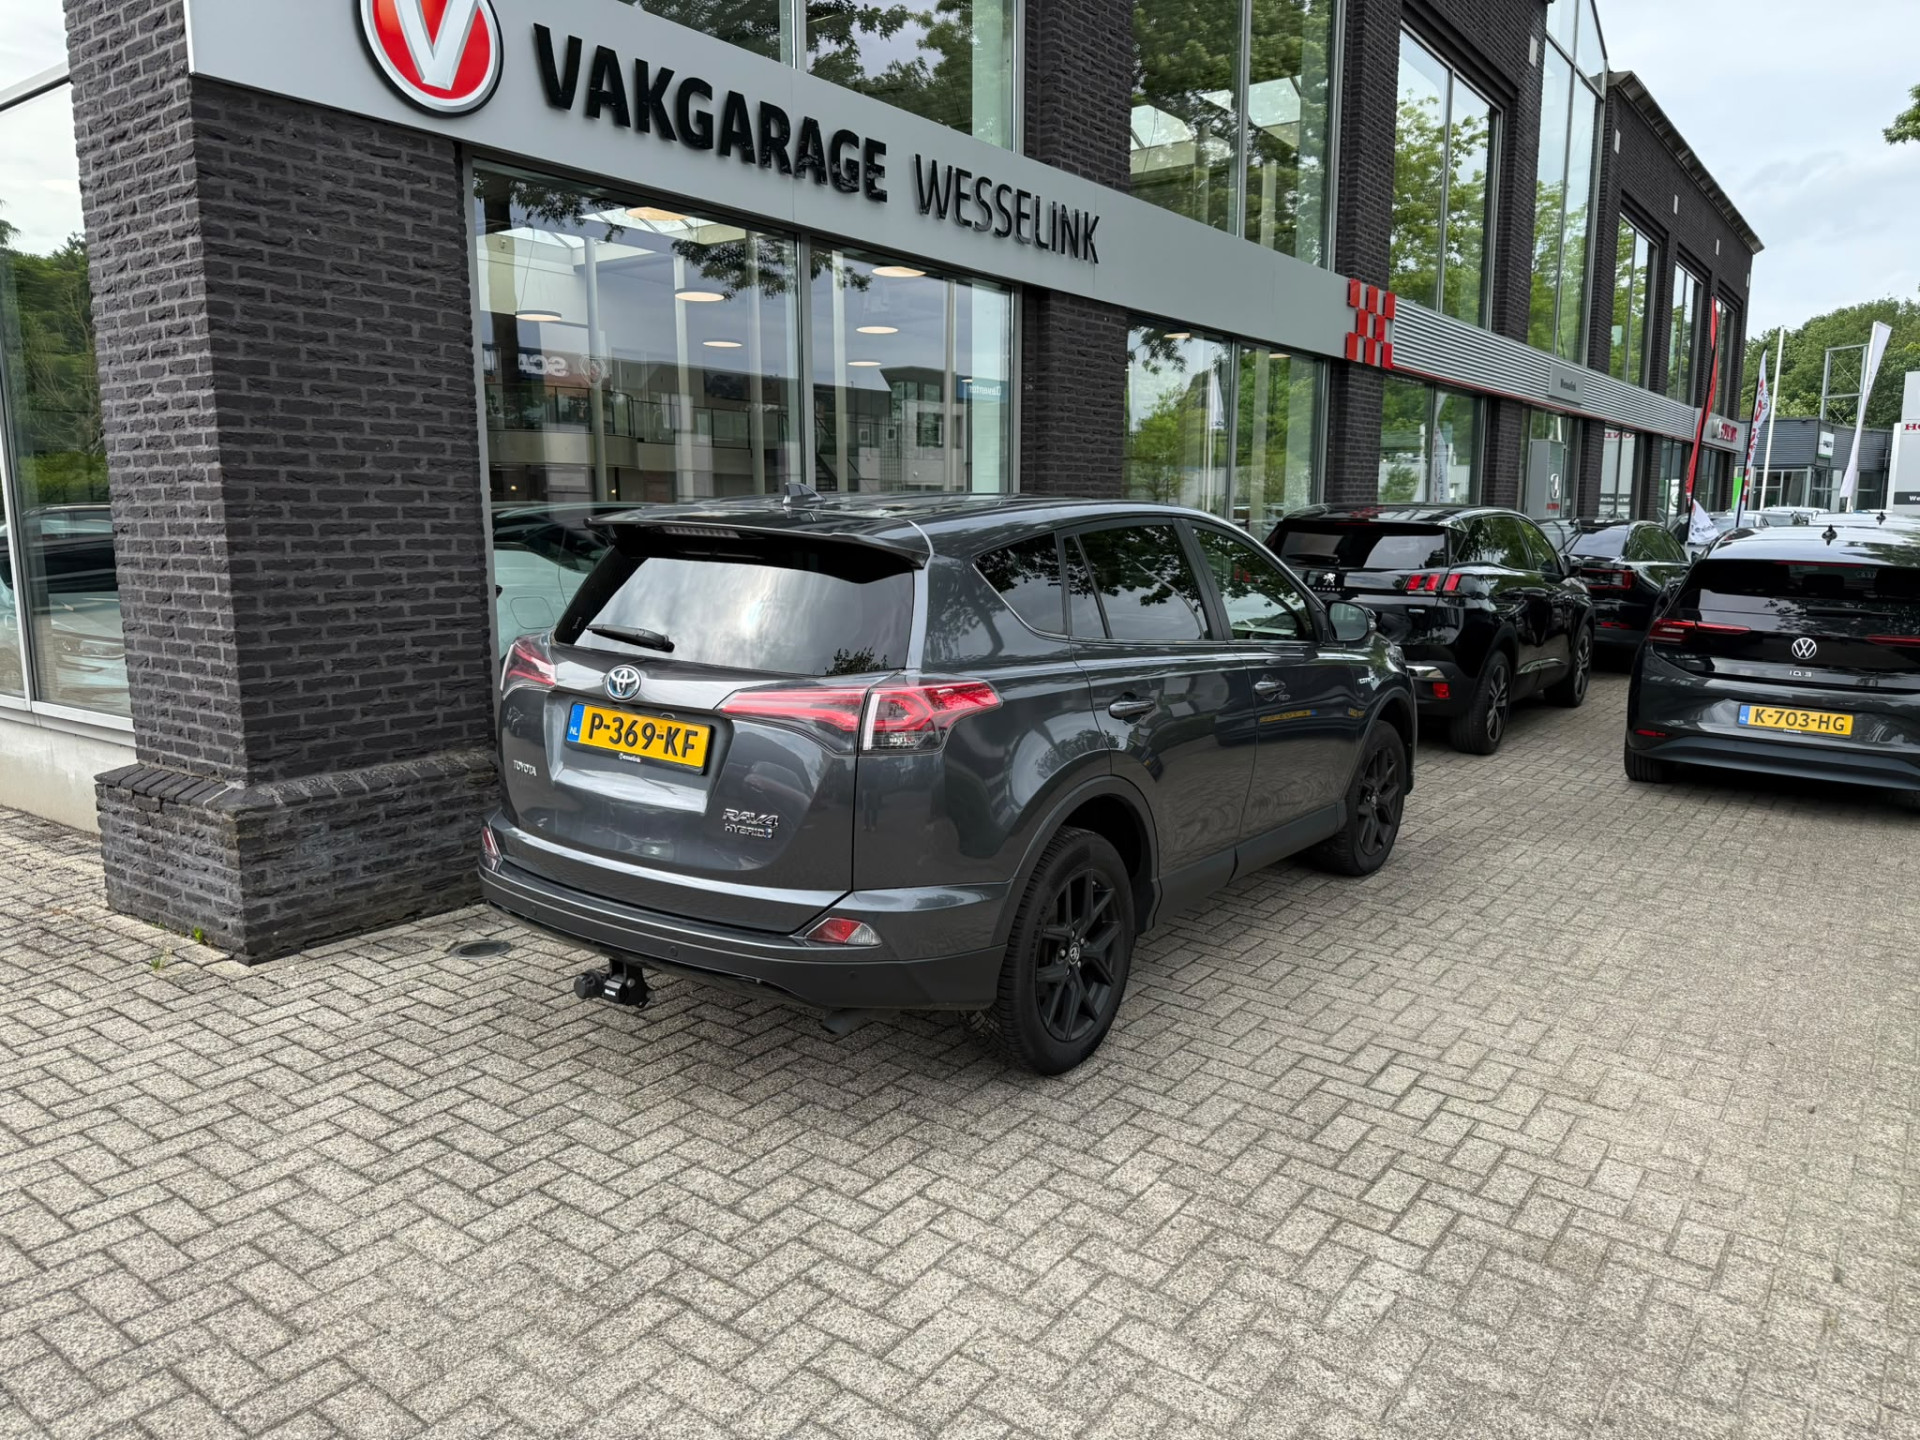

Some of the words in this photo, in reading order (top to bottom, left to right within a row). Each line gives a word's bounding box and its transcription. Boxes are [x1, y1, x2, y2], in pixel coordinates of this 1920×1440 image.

[533, 23, 888, 203] VAKGARAGE
[914, 153, 1100, 265] WESSELINK
[1753, 708, 1846, 732] K-703-HG
[569, 726, 578, 736] NL
[588, 712, 699, 758] P-369-KF
[513, 759, 537, 777] TOYOTA
[722, 808, 779, 829] RAV4
